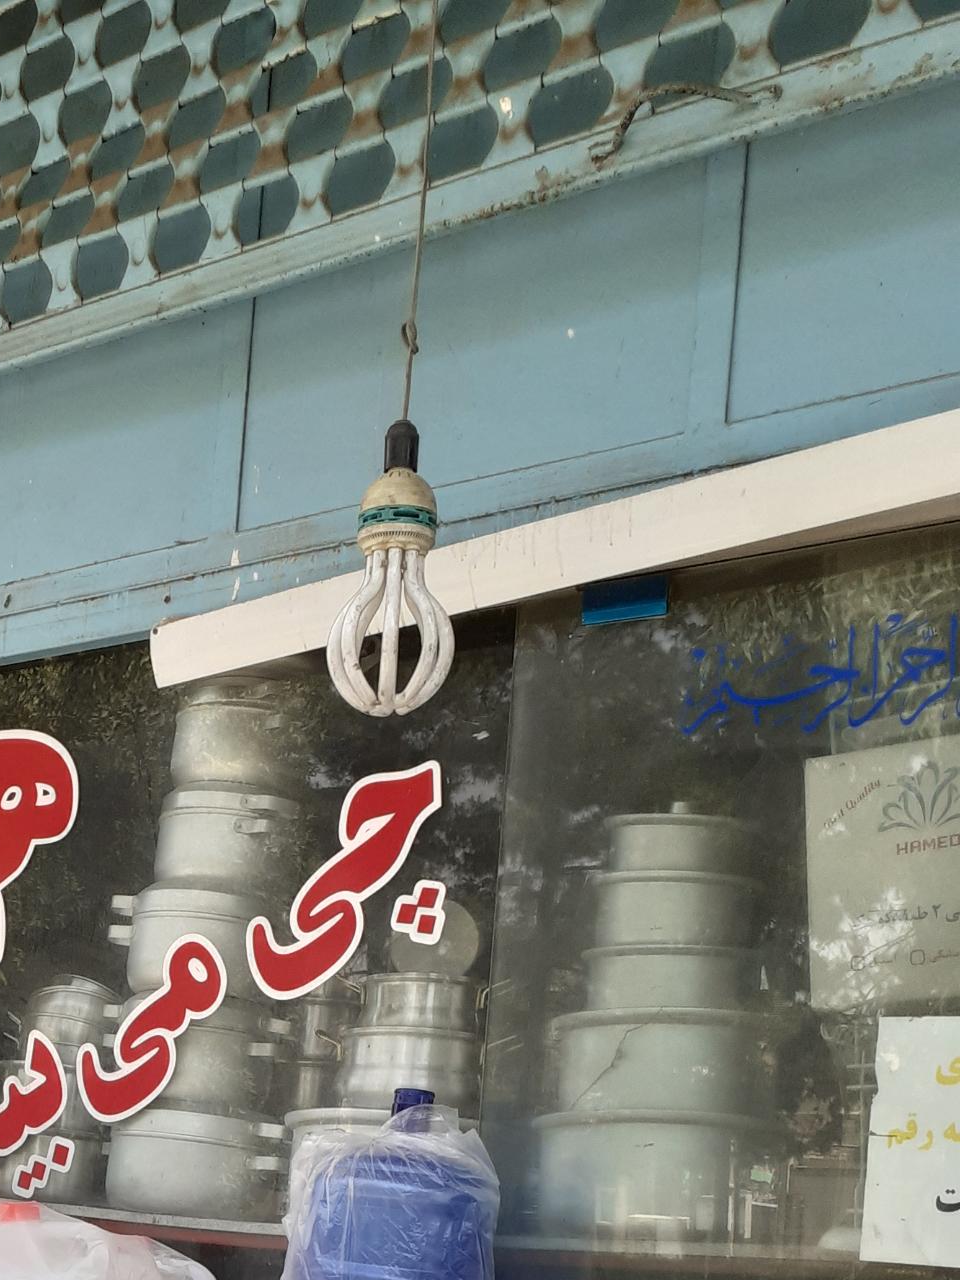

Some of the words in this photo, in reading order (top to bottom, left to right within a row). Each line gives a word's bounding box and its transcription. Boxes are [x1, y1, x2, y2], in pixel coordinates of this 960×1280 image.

[245, 759, 446, 1000] چی
[76, 932, 228, 1124] می
[886, 1112, 934, 1152] رقم
